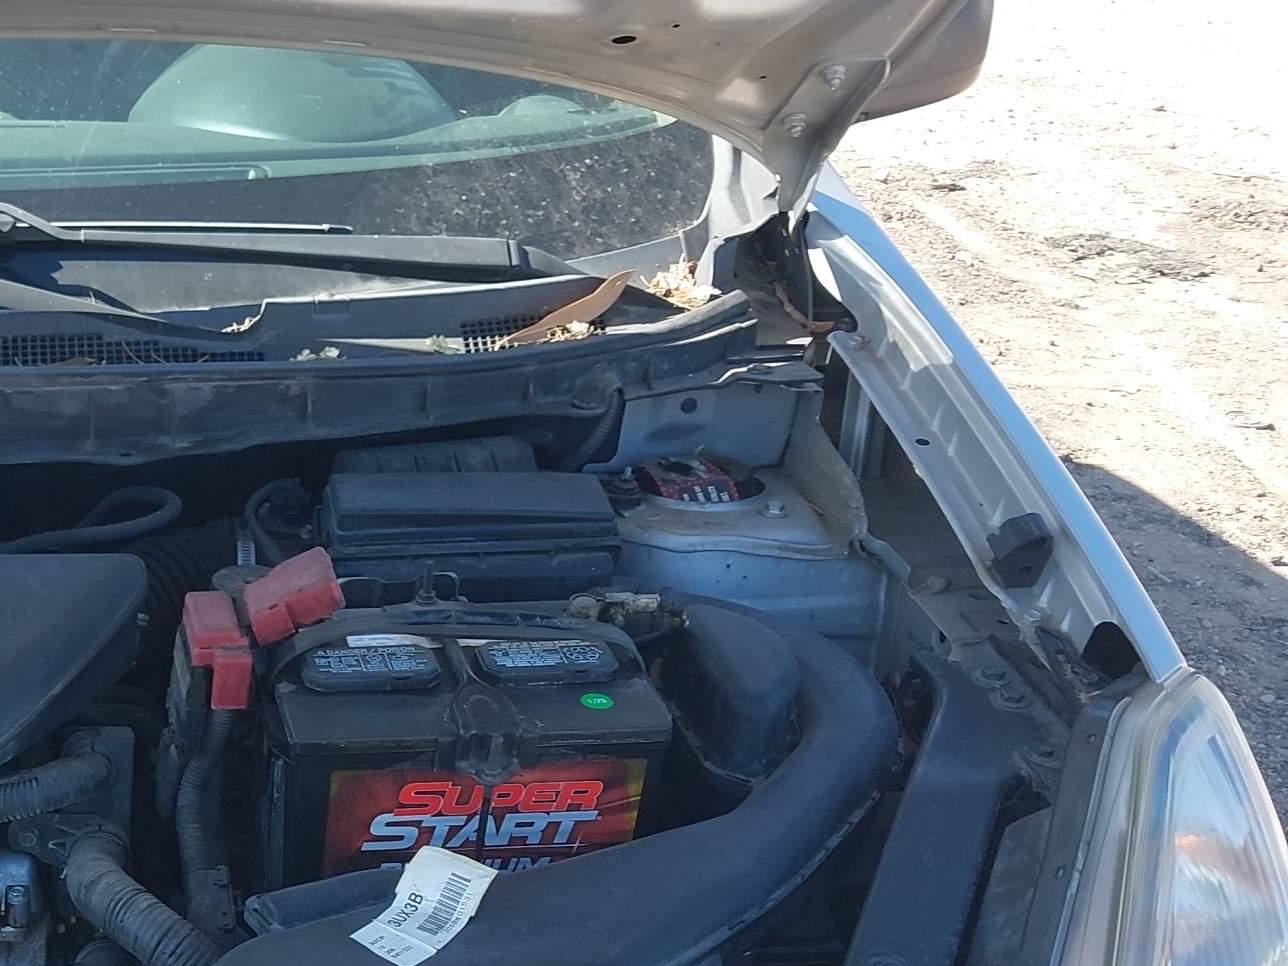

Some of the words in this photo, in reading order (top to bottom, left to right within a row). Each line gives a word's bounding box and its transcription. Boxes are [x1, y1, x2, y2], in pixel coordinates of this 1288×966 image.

[392, 781, 604, 816] SUPER
[361, 810, 600, 850] START
[387, 892, 424, 928] 3UX3B
